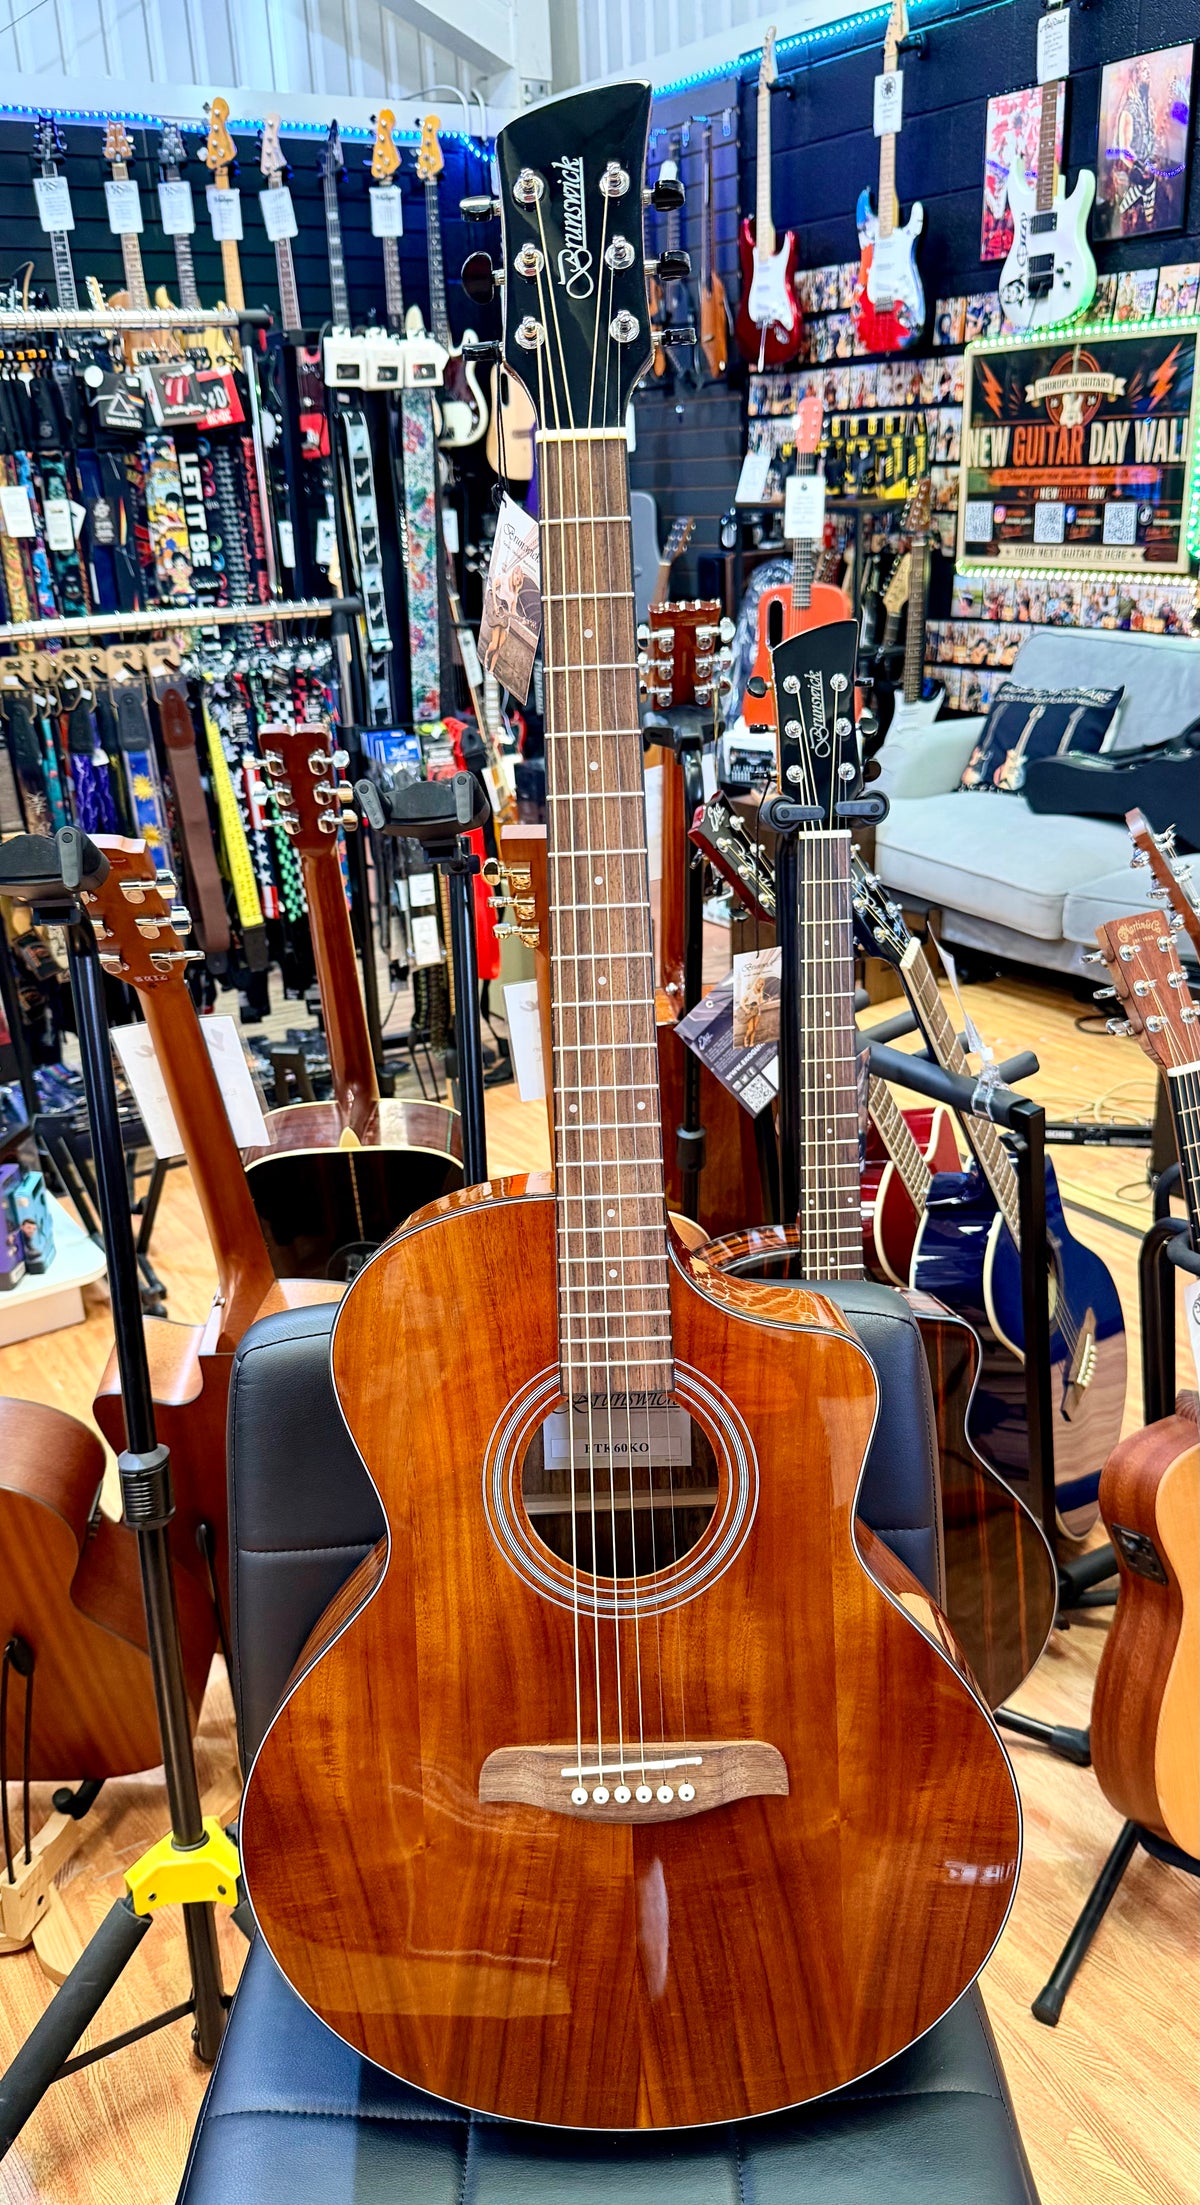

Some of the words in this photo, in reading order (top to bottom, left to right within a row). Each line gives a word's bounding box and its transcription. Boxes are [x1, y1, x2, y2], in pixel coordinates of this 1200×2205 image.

[551, 155, 594, 299] Brunswick
[966, 426, 1010, 468] NEW
[1012, 425, 1085, 467] GUITAR
[1088, 420, 1131, 465] DAY
[178, 452, 203, 501] LET
[186, 503, 208, 531] IT
[189, 534, 212, 568] BE
[804, 670, 831, 758] Brunswick
